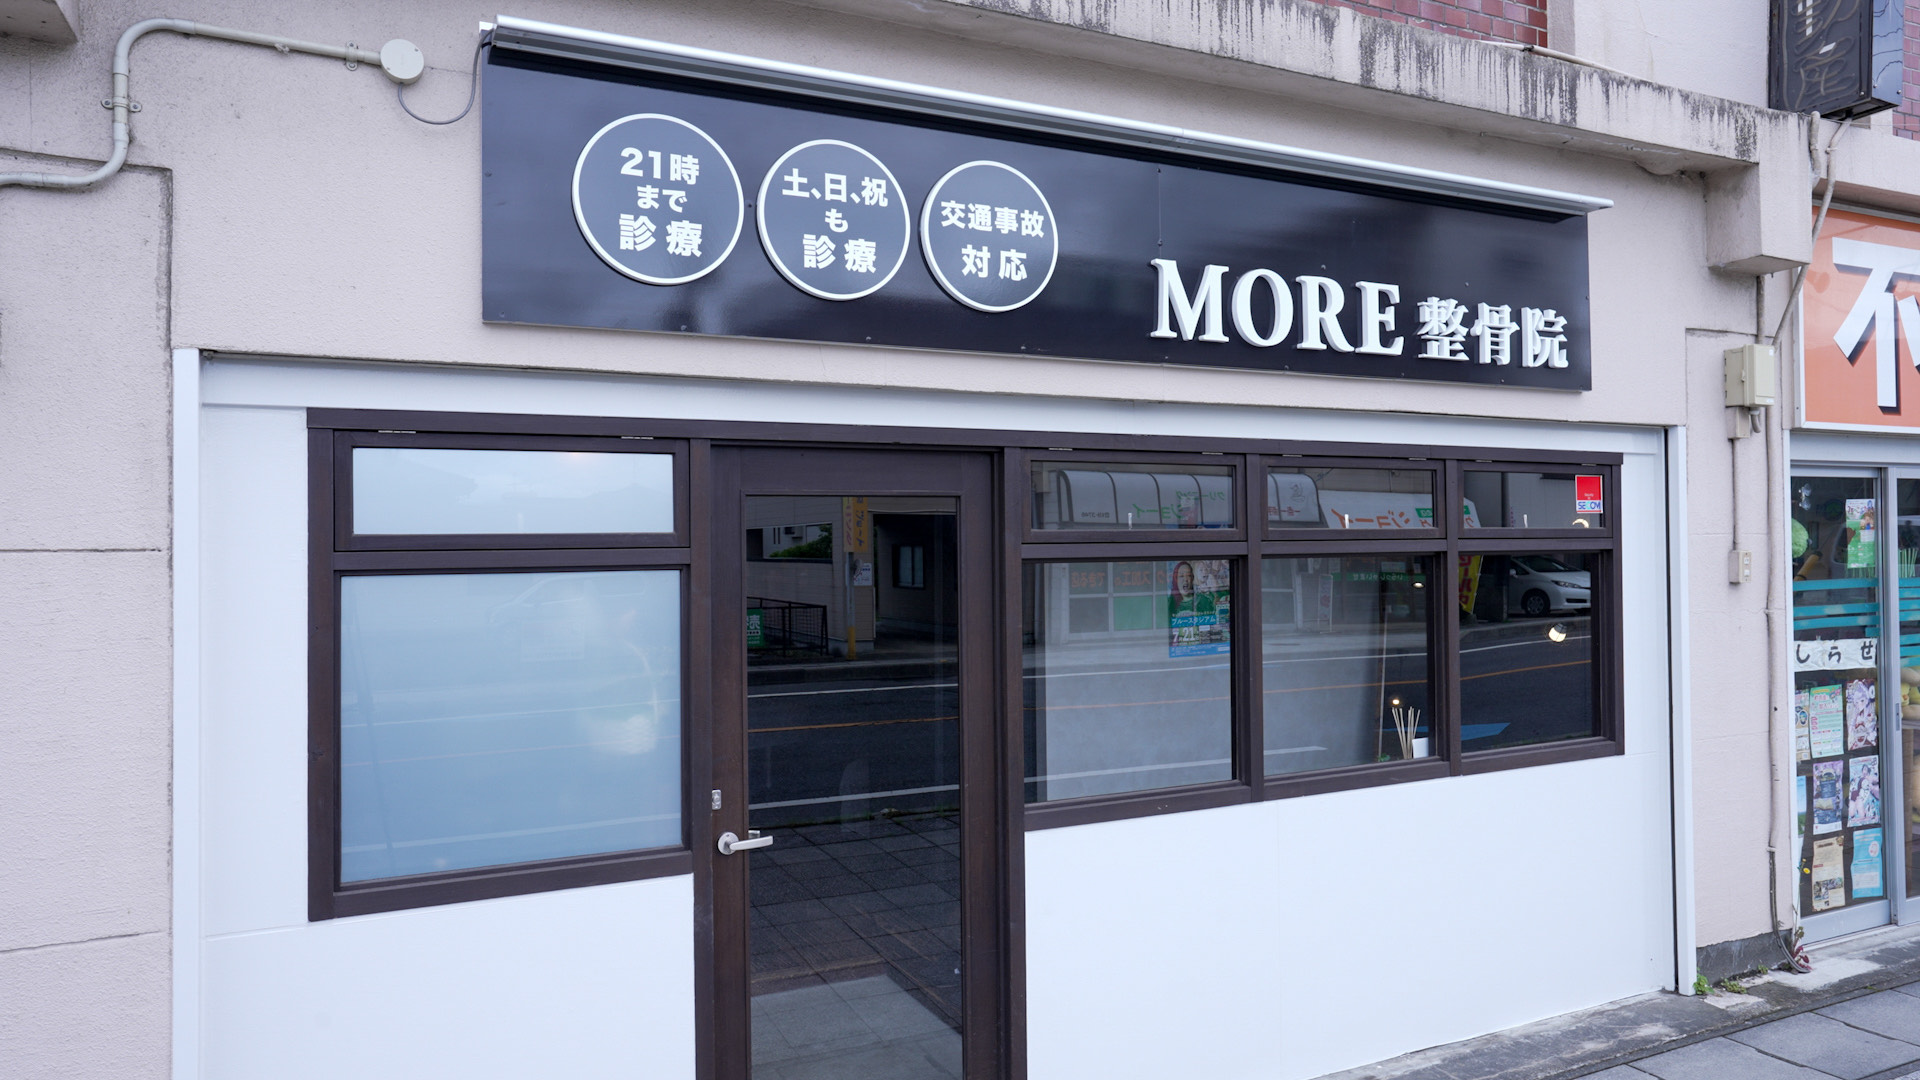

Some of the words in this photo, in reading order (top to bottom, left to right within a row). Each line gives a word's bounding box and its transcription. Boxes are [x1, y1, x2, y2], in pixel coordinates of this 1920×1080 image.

[619, 147, 700, 185] 21時
[636, 185, 688, 213] まで
[781, 168, 889, 208] 土、日、祝
[618, 213, 703, 258] 診療
[824, 208, 849, 232] も
[940, 200, 1045, 238] 交通事故
[802, 234, 877, 273] 診療
[961, 244, 1028, 281] 対応
[1150, 258, 1404, 356] MORE
[1415, 296, 1569, 369] 整骨院
[1577, 501, 1601, 510] SECOM
[1796, 640, 1873, 664] しらせ
